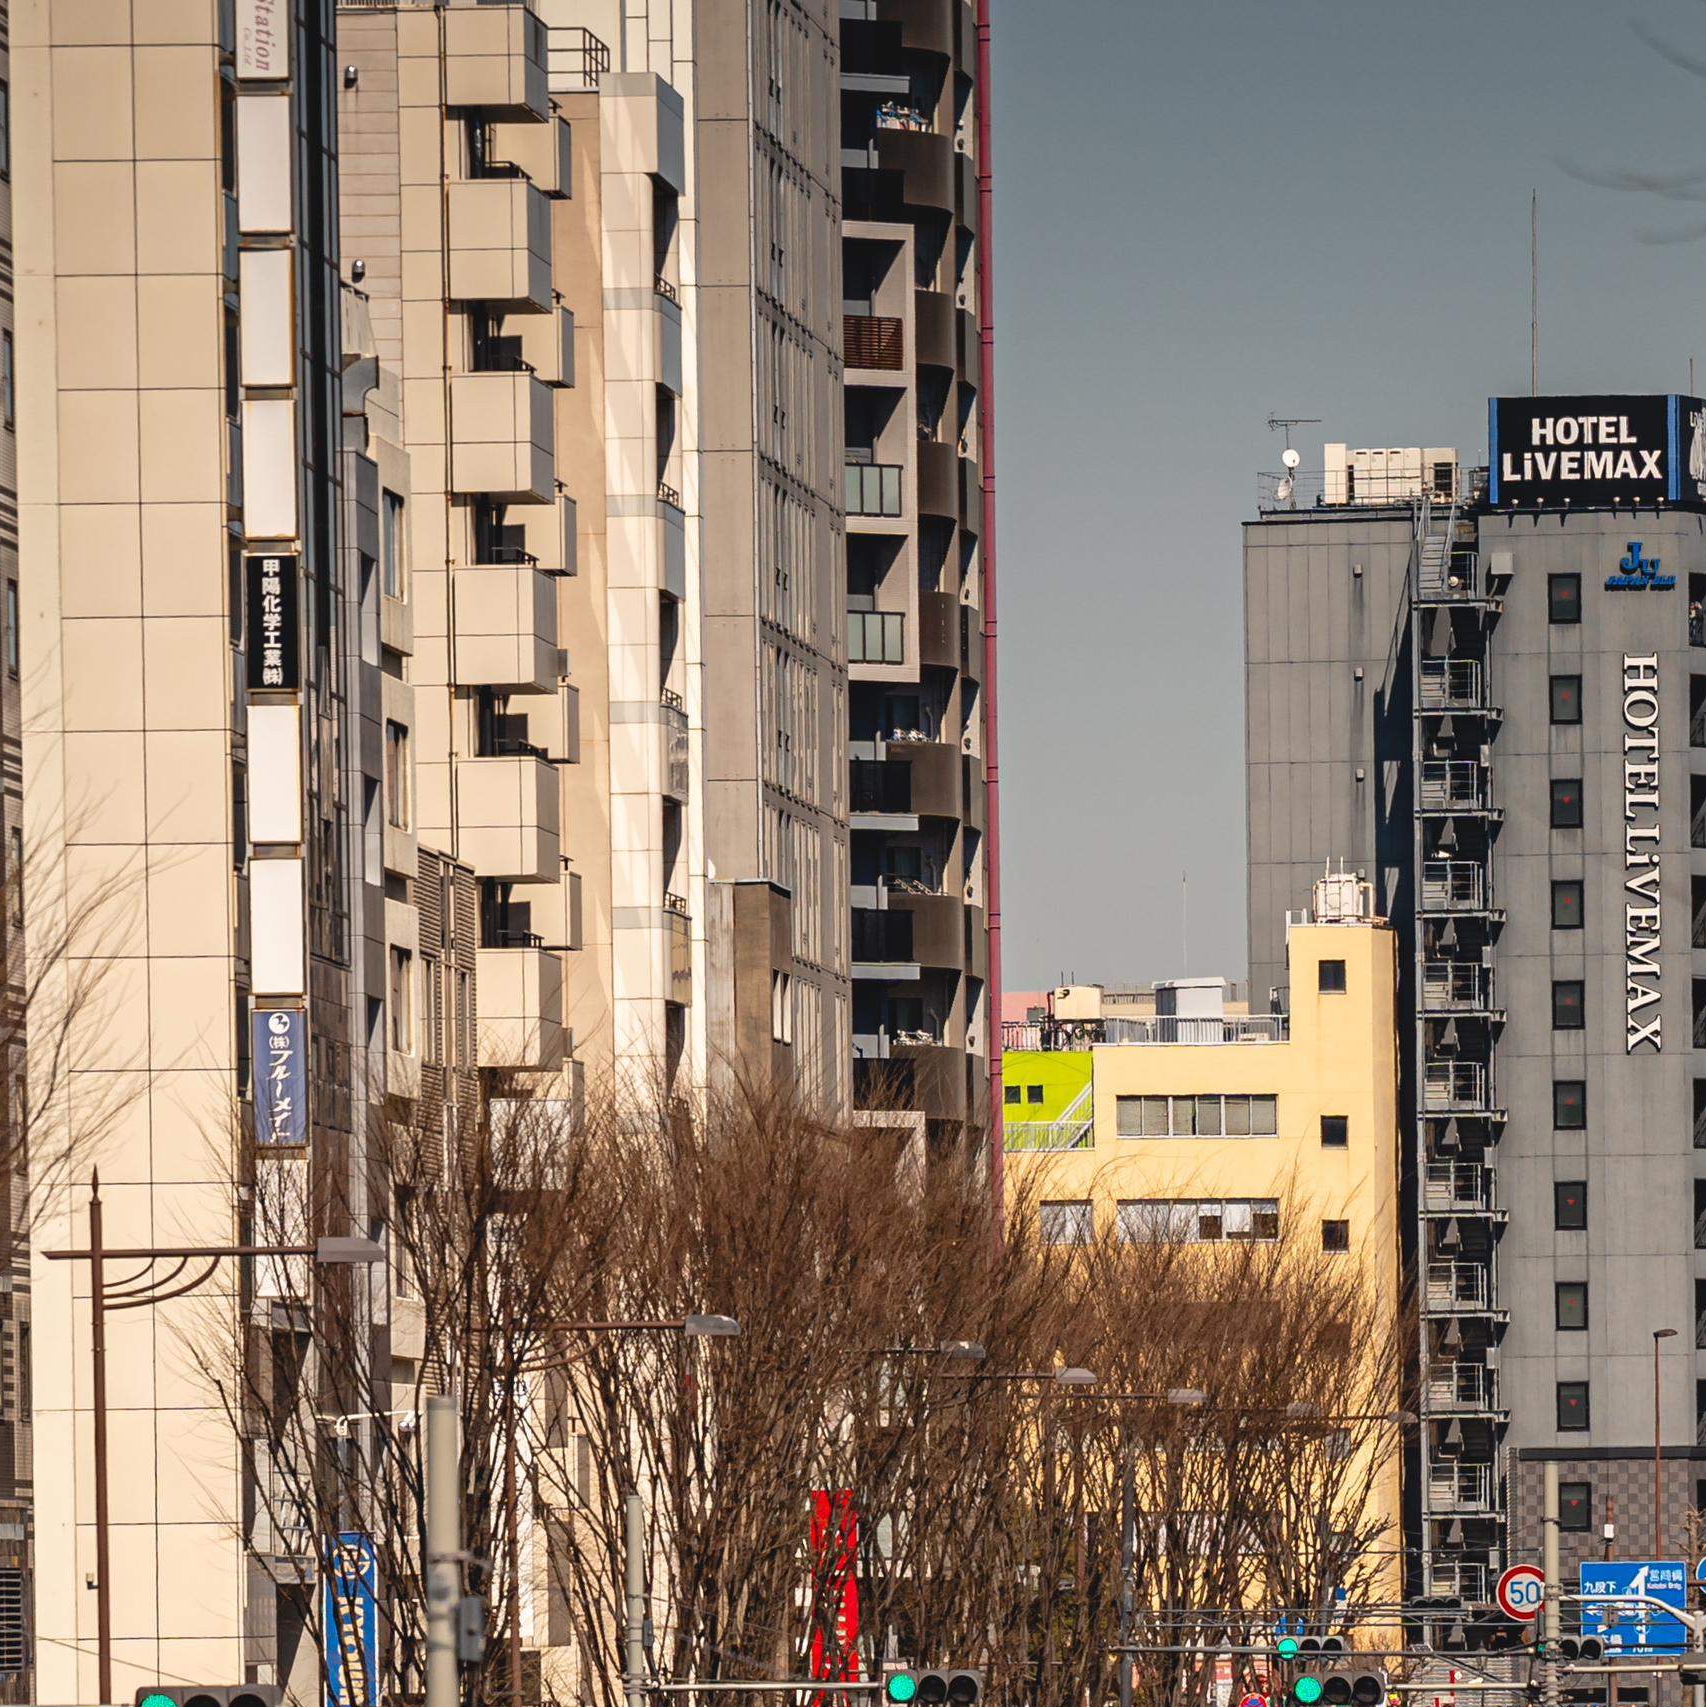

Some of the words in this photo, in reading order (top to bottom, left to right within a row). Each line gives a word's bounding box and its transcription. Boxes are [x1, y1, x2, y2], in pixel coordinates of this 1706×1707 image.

[1532, 416, 1637, 446] HOTEL
[1502, 450, 1663, 481] LiVEMAX
[1623, 652, 1660, 820] HOTEL
[1625, 823, 1663, 1055] LiVEMAX
[1510, 1581, 1541, 1605] 50
[1584, 1581, 1617, 1595] 九段下
